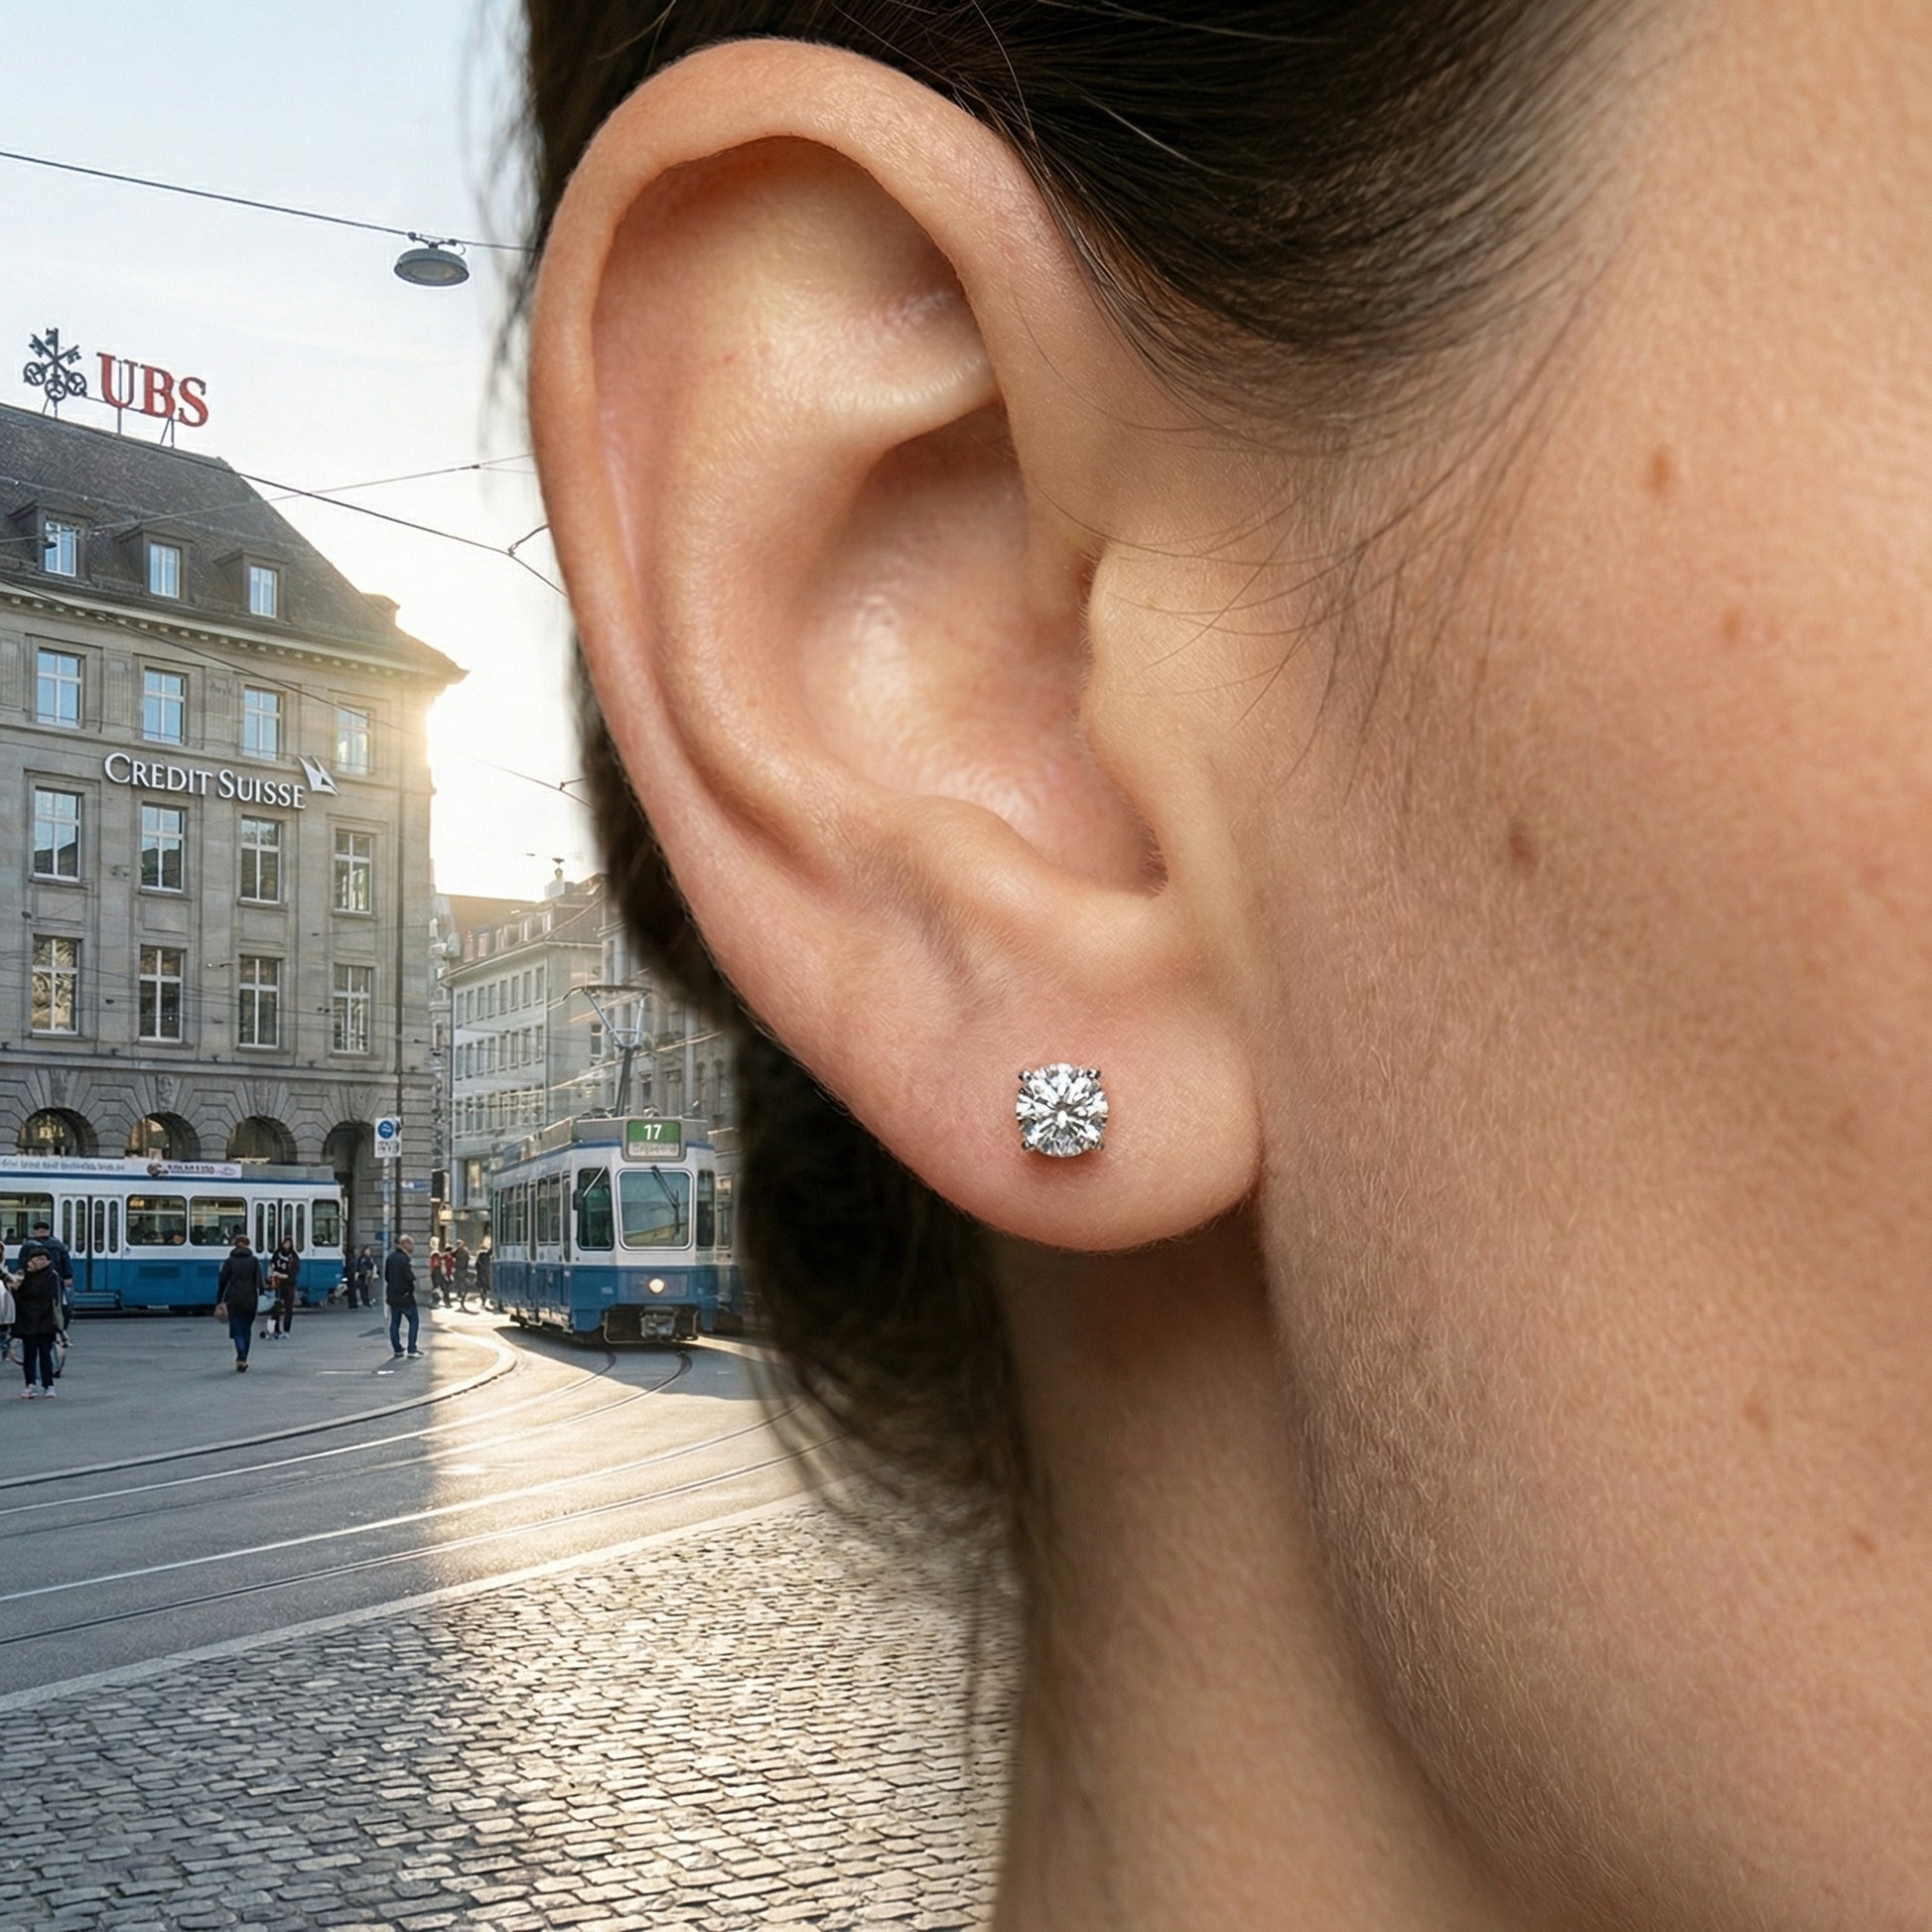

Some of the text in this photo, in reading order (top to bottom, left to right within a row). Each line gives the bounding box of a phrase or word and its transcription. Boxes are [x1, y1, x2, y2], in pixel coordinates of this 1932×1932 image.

[96, 351, 208, 427] UBS
[104, 753, 307, 808] CREDIT SUISSE
[643, 1124, 662, 1140] 17
